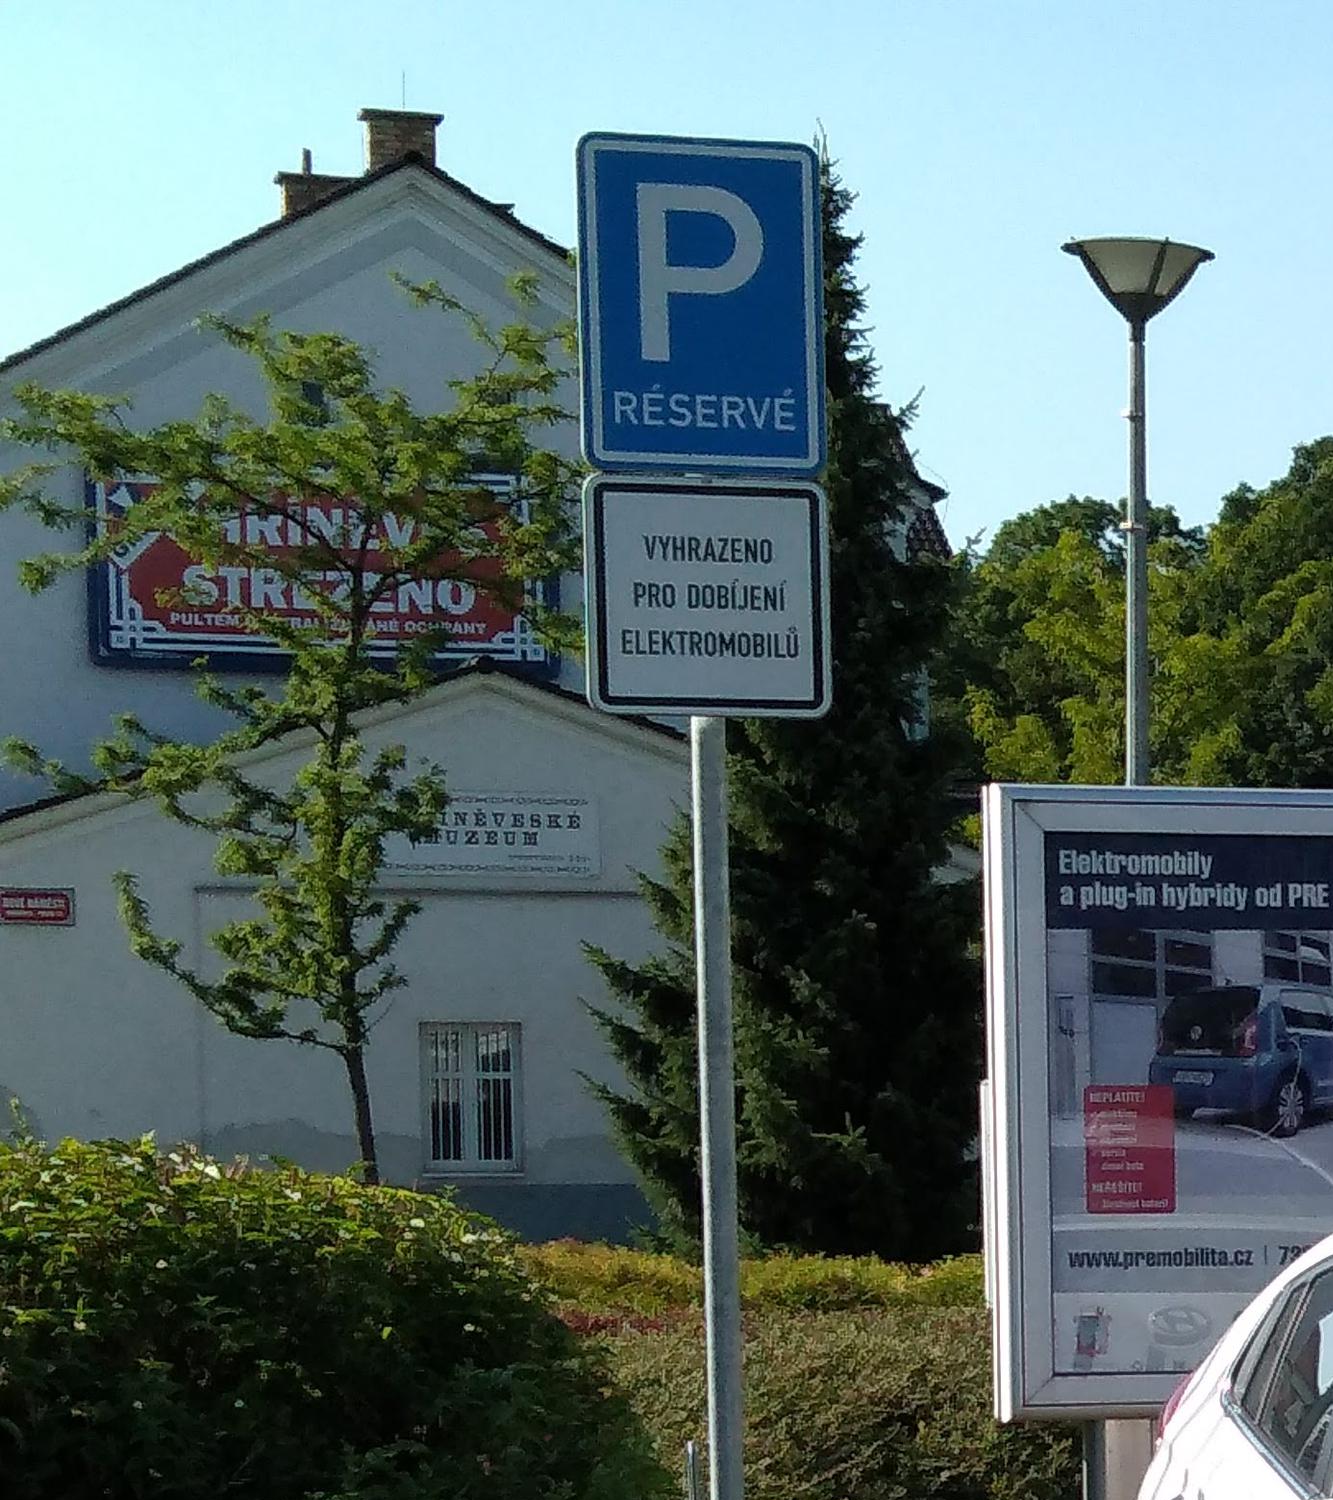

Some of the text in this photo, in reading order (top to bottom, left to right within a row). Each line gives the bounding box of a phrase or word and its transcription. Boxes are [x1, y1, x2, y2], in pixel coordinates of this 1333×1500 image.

[636, 182, 763, 361] P
[613, 384, 797, 431] RÉSERVÉ
[643, 535, 774, 565] VYHRAZENO
[633, 578, 787, 612] PRO DOBÍJENÍ
[621, 626, 800, 661] ELEKTROMOBILŮ
[1058, 850, 1213, 879] Elektromobily
[1060, 882, 1330, 911] a plug-in hybridy od PRE
[1068, 1247, 1253, 1270] www.premobilita.cz
